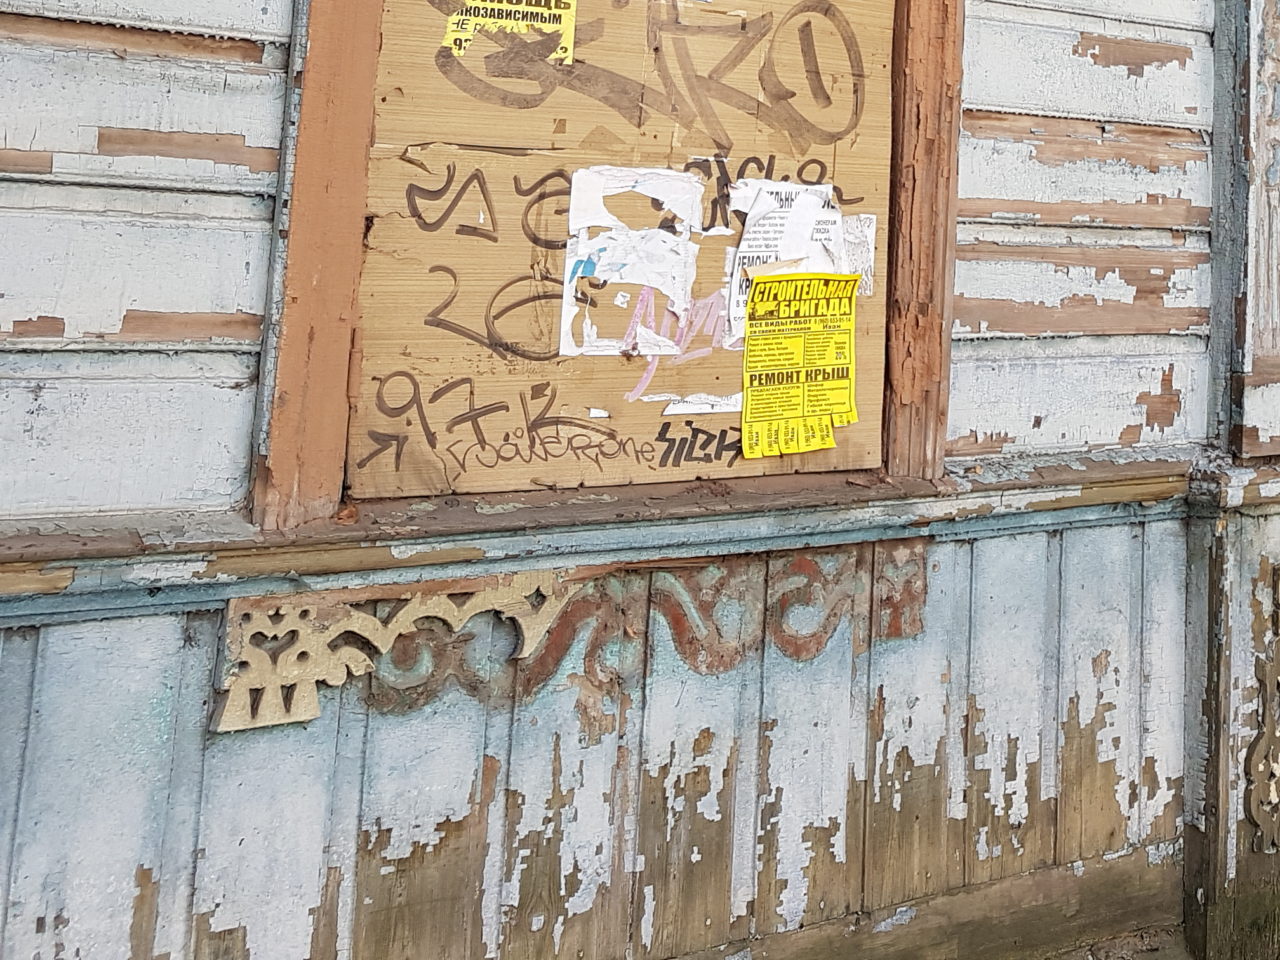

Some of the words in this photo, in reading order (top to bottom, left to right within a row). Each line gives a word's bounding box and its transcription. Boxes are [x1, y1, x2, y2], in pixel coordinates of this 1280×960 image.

[753, 279, 856, 303] СТРОИТЕЛЬНАЯ
[779, 297, 851, 318] БРИГАДА
[789, 318, 812, 326] РАБОТ
[749, 370, 802, 387] РЕМОНТ
[805, 366, 850, 382] КРЫШ
